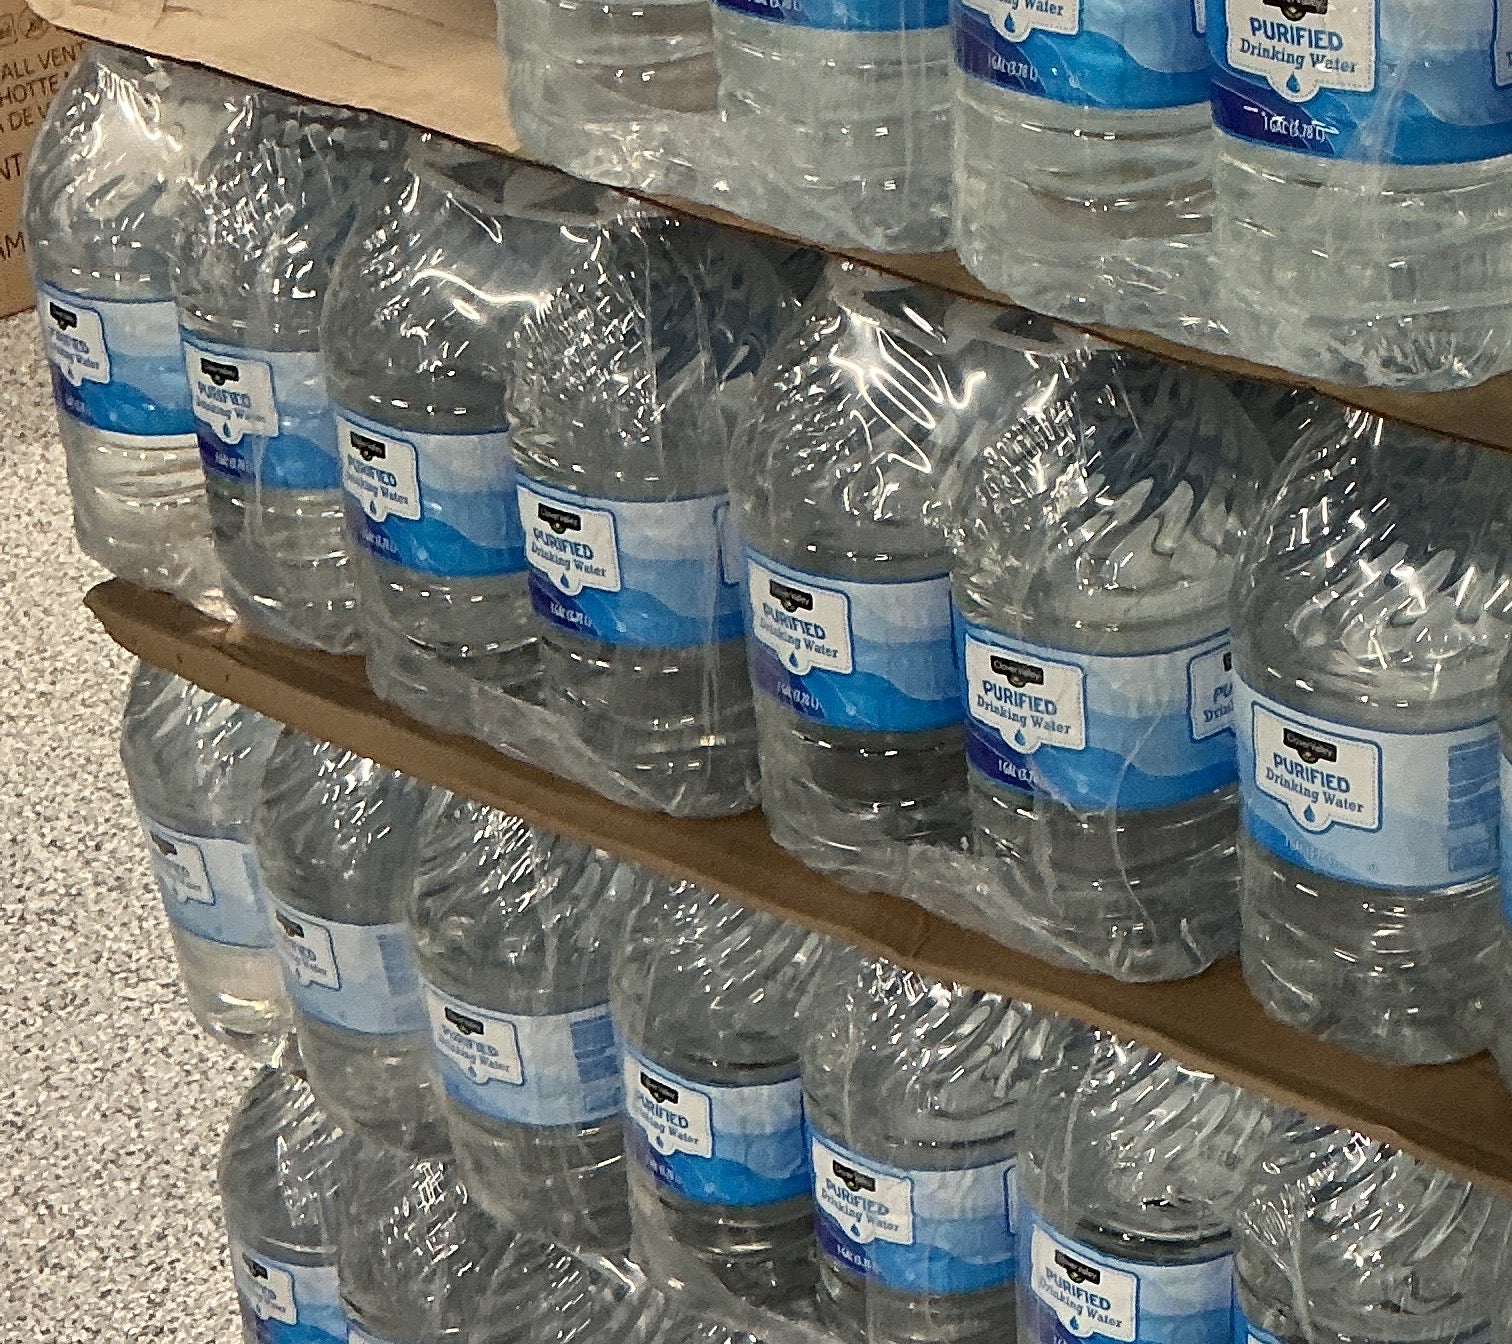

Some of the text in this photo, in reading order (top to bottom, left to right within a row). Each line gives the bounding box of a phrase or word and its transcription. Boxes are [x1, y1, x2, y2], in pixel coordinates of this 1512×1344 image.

[1249, 17, 1343, 52] PURIFIED
[1239, 37, 1358, 74] Drinking Water
[531, 545, 608, 578] Drinking Water
[533, 527, 594, 560] PURIFIED
[762, 602, 827, 641] PURIFIED
[803, 638, 840, 659] Water
[976, 695, 1072, 735] Drinking Water
[982, 679, 1058, 716] PURIFIED
[1265, 767, 1365, 814] Drinking Water
[1273, 752, 1350, 794] PURIFIED
[826, 1177, 890, 1216] PURIFIED
[866, 1211, 900, 1233] Water
[1038, 1278, 1123, 1329] Drinking Water
[1046, 1267, 1111, 1312] PURIFIED
